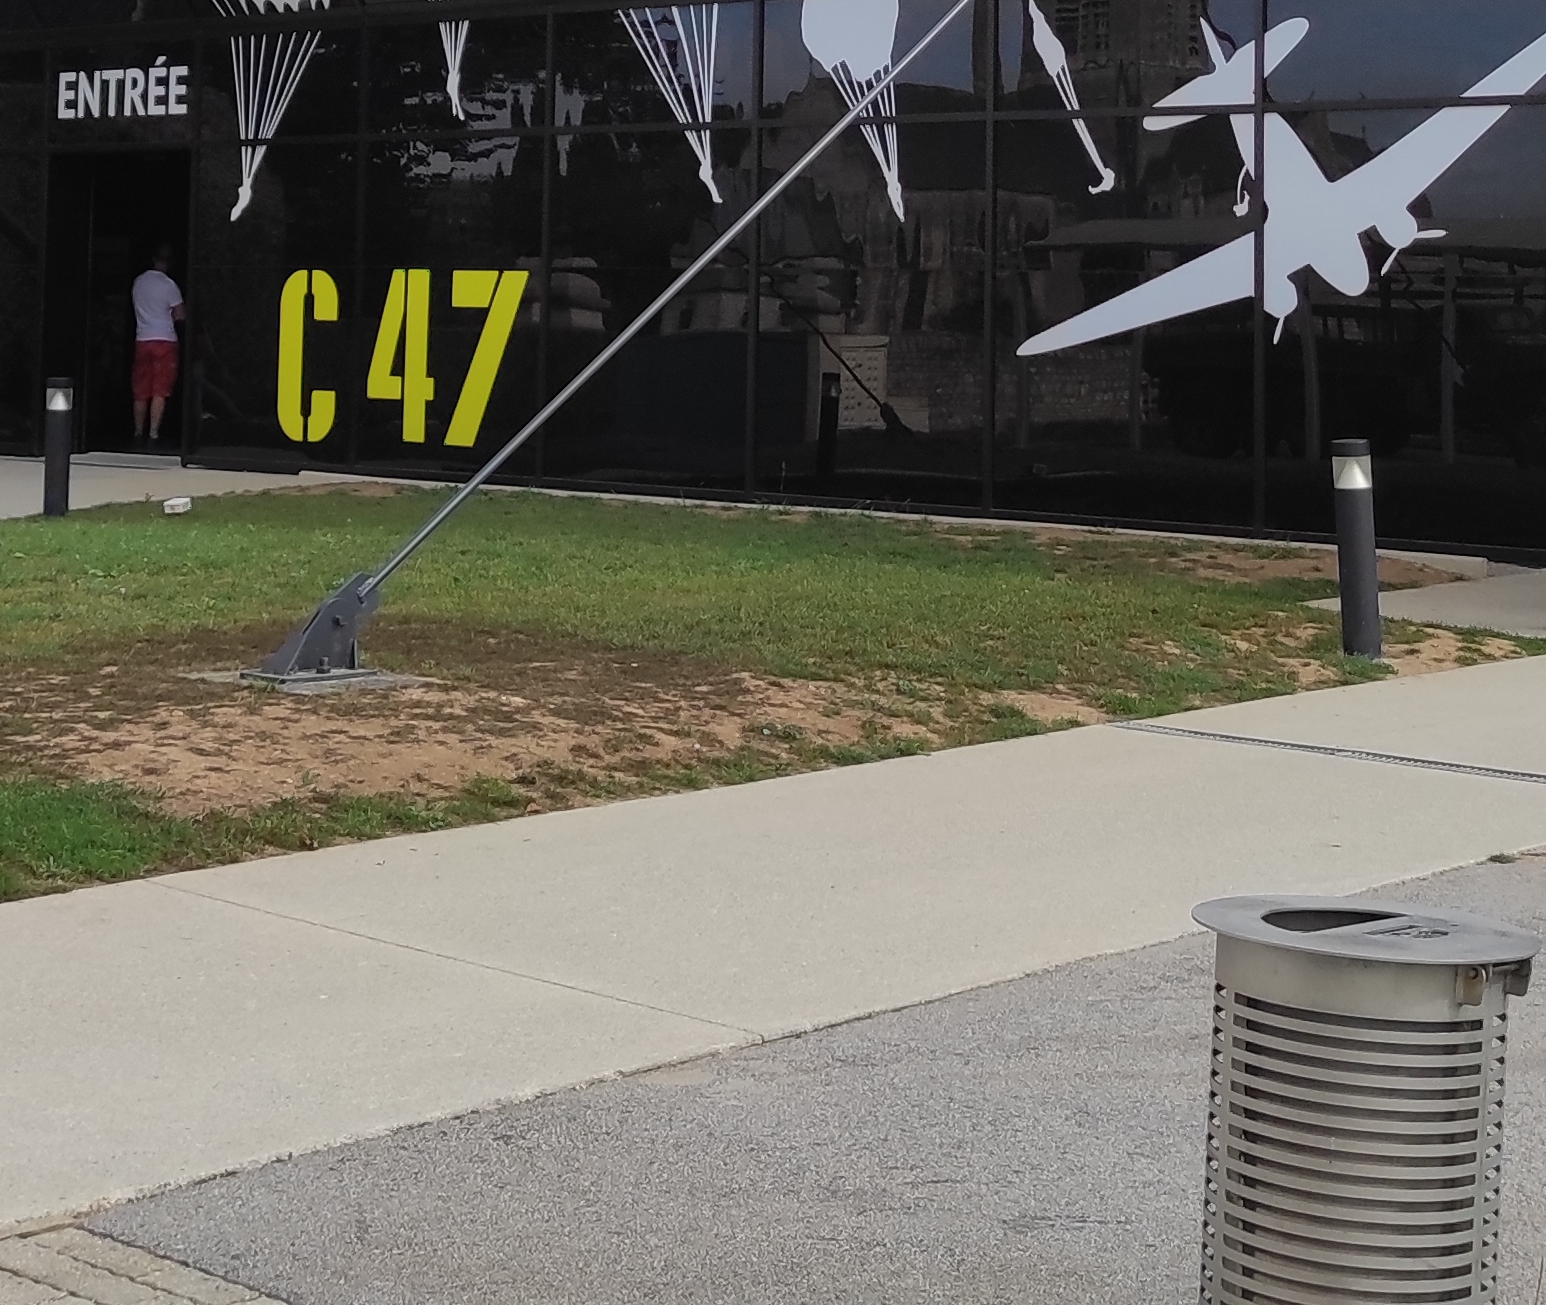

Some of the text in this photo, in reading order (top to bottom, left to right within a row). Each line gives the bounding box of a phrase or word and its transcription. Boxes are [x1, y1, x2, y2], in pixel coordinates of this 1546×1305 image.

[57, 55, 189, 120] ENTRÉE
[276, 268, 530, 448] C 47
